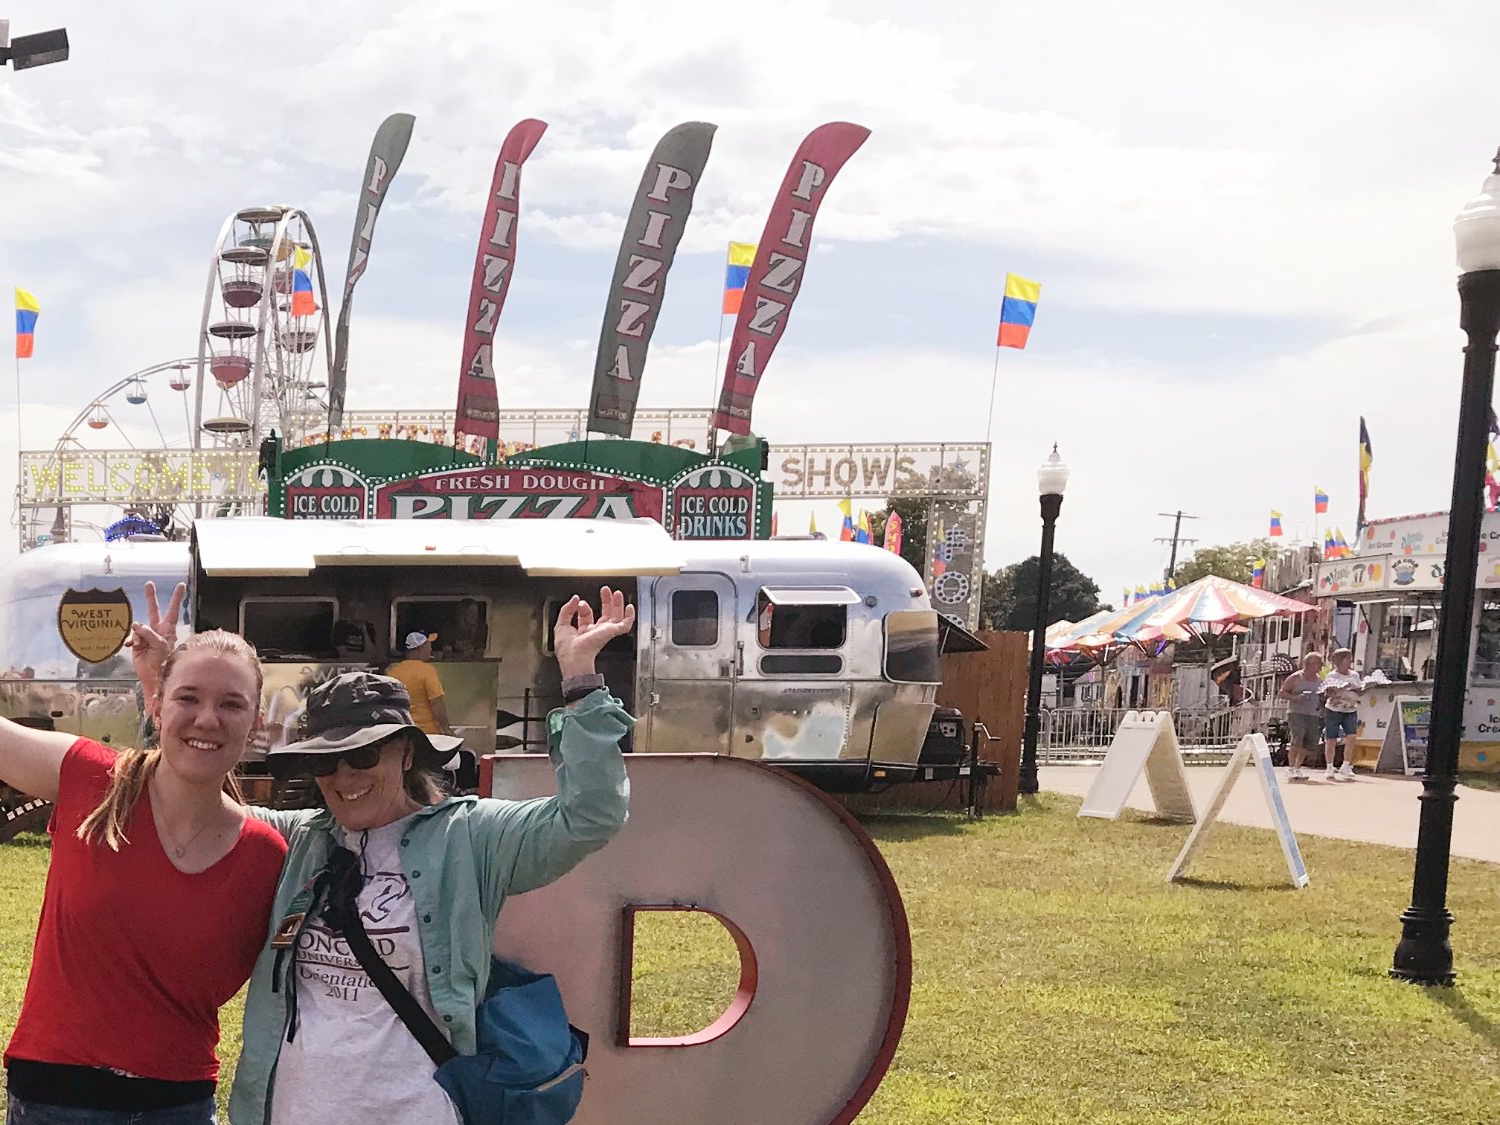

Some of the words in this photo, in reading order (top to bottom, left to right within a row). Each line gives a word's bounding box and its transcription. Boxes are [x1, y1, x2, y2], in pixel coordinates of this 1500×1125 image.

[606, 162, 693, 383] PIZZA
[734, 160, 826, 378] PIZZA
[31, 462, 211, 494] WELCOME
[781, 455, 925, 487] SHOWS
[435, 475, 510, 490] FRESH
[523, 475, 605, 490] DOUGH
[293, 495, 316, 512] ICE
[320, 495, 360, 512] COLD
[391, 495, 635, 519] PIZZA
[681, 496, 705, 513] ICE
[708, 496, 749, 513] COLD
[681, 516, 747, 536] DRINKS
[71, 609, 112, 619] WEST
[62, 619, 127, 631] VIRGINIA
[325, 984, 358, 1002] 2011
